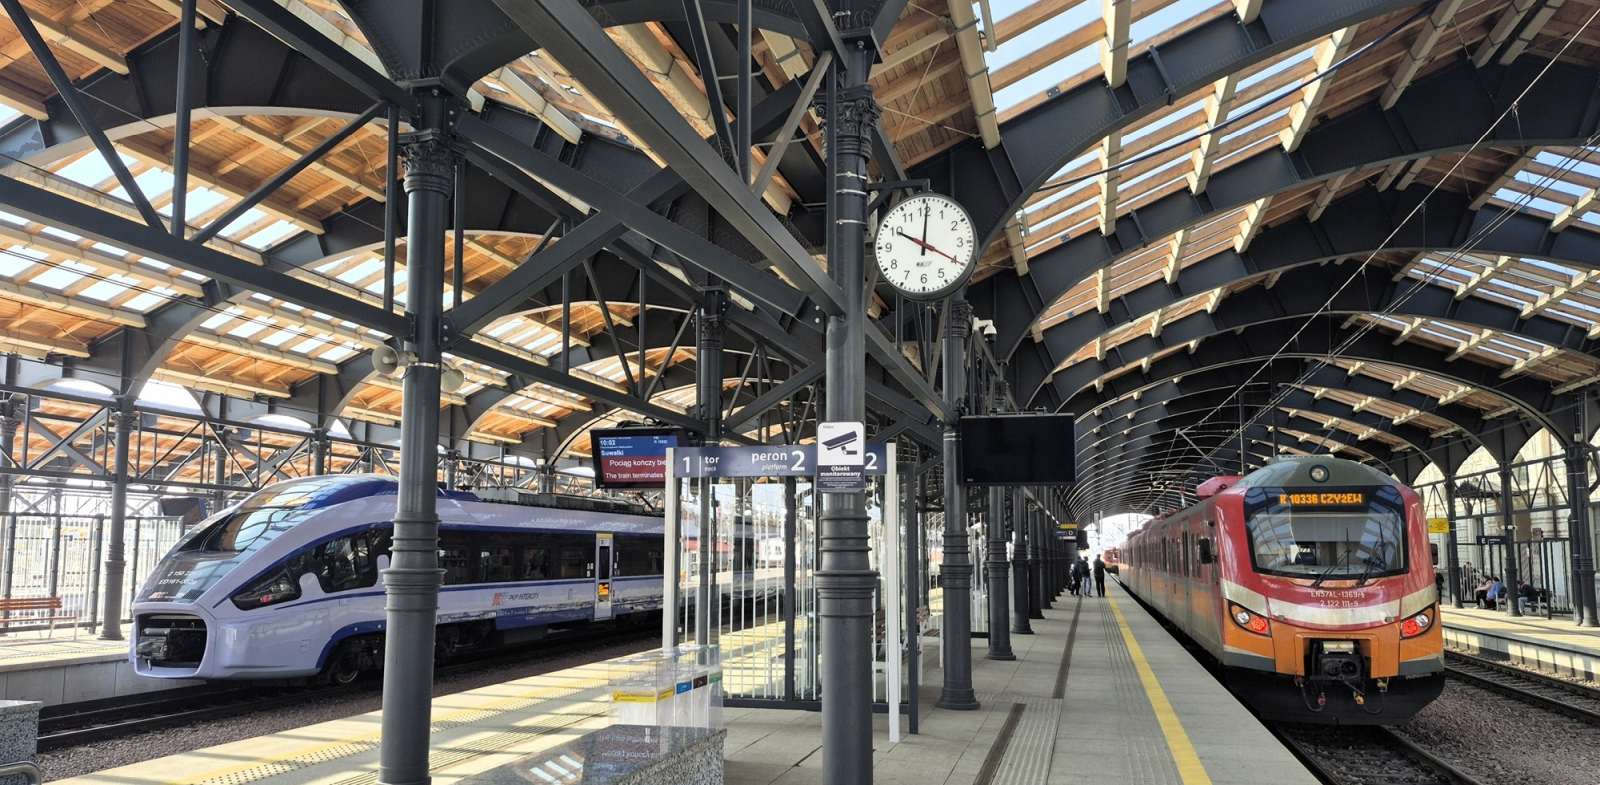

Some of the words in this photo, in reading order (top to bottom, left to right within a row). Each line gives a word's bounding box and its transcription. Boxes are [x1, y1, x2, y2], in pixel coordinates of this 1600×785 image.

[918, 206, 931, 217] 12
[939, 209, 944, 219] 1
[903, 212, 913, 223] 11
[951, 220, 958, 231] 2
[890, 226, 904, 237] 10
[885, 242, 892, 253] 9
[957, 237, 964, 248] 3
[890, 258, 898, 270] 8
[950, 254, 957, 265] 4
[904, 269, 911, 280] 7
[920, 273, 928, 284] 6
[937, 268, 945, 279] 5
[609, 459, 632, 467] Pociąg
[633, 459, 656, 467] kończy
[682, 456, 691, 473] 1
[704, 455, 720, 464] tor
[751, 450, 788, 465] peron
[790, 450, 806, 472] 2
[864, 452, 878, 470] 2
[761, 464, 788, 472] platform
